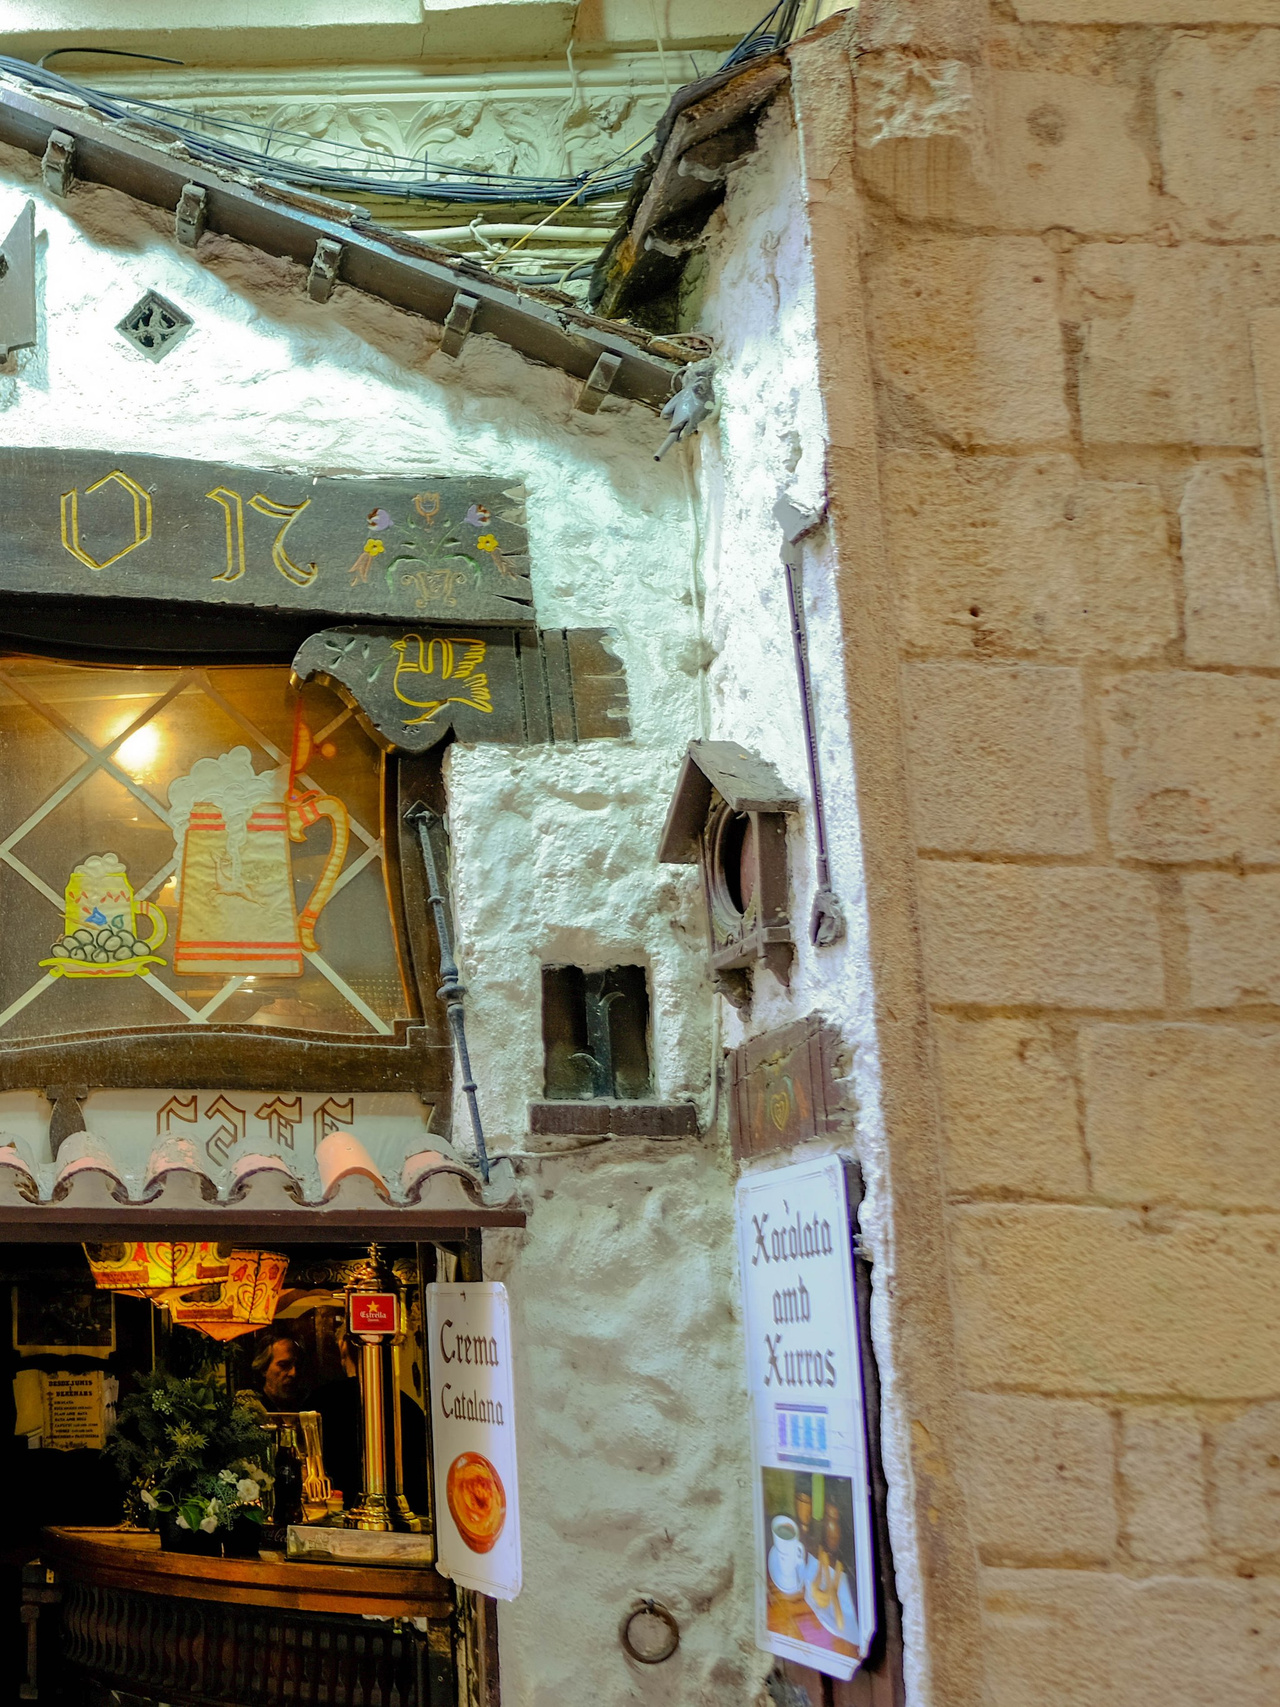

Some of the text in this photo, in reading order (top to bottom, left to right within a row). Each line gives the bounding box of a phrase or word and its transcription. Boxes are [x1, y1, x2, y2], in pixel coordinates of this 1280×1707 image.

[772, 1273, 811, 1325] amb
[763, 1332, 836, 1389] Xurros
[440, 1381, 505, 1426] Catalana
